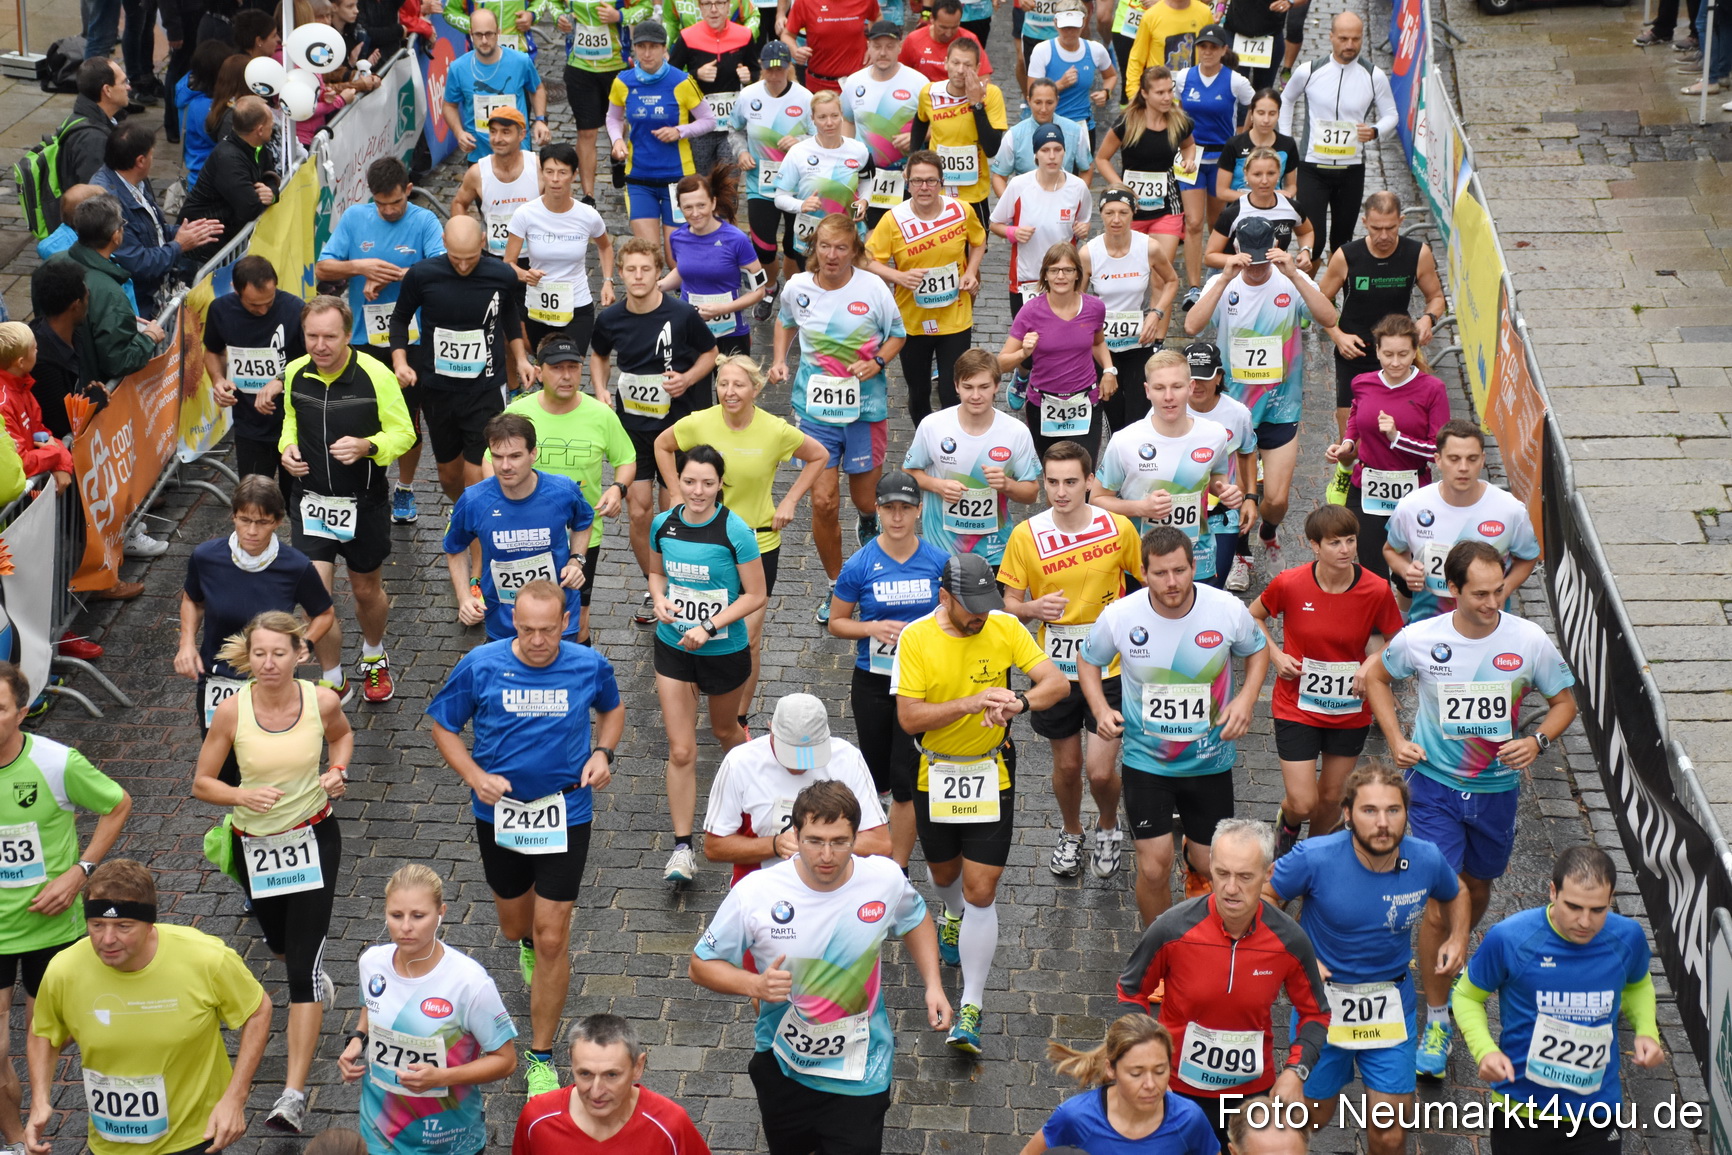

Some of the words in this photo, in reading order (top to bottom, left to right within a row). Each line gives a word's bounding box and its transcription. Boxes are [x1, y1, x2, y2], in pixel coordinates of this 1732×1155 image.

[578, 33, 608, 47] 2835
[1243, 41, 1264, 53] 174
[933, 110, 956, 121] MAX
[1323, 130, 1350, 145] 317
[1323, 146, 1346, 154] Thomas
[1127, 181, 1163, 197] 2733
[907, 239, 936, 256] MAX
[939, 225, 967, 244] BÖGL
[919, 274, 955, 294] 2811
[541, 293, 559, 309] 96
[924, 294, 953, 303] Christoph
[539, 312, 560, 320] Brigitte
[1102, 322, 1139, 337] 2497
[440, 340, 480, 359] 2577
[1245, 349, 1267, 366] 72
[234, 358, 275, 376] 2458
[449, 364, 471, 372] Tobias
[629, 385, 659, 402] 222
[813, 387, 856, 405] 2616
[634, 402, 658, 414] Thomas
[822, 409, 844, 417] Achim
[1046, 404, 1087, 421] 2435
[992, 450, 1009, 459] Hervis
[1368, 481, 1414, 499] 2302
[948, 499, 993, 516] 2622
[307, 503, 351, 528] 2052
[955, 520, 985, 529] Andreas
[1482, 524, 1501, 533] Hervis
[492, 528, 551, 543] HUBER
[1042, 555, 1078, 575] MAX
[1082, 542, 1121, 562] BÖGL
[665, 560, 709, 575] HUBER
[872, 579, 930, 594] HUBER
[674, 599, 722, 621] 2062
[1198, 634, 1220, 644] Hervis
[1497, 658, 1520, 667] Hervis
[1307, 673, 1354, 696] 2312
[502, 689, 568, 704] HUBER
[1150, 698, 1204, 719] 2514
[1446, 696, 1507, 720] 2789
[1160, 725, 1192, 733] Markus
[1457, 726, 1498, 735] Matthias
[1197, 737, 1212, 748] 17.
[944, 776, 985, 799] 267
[502, 805, 560, 829] 2420
[951, 804, 978, 815] Bernd
[515, 836, 548, 846] Werner
[253, 842, 312, 872] 2131
[267, 873, 305, 887] Manuela
[862, 905, 883, 918] Hervis
[1536, 990, 1614, 1007] HUBER
[424, 1002, 450, 1013] Hervis
[1342, 996, 1387, 1023] 207
[784, 1024, 845, 1056] 2323
[1352, 1028, 1381, 1039] Frank
[790, 1052, 821, 1067] Stefan
[1190, 1041, 1256, 1073] 2099
[1539, 1035, 1606, 1069] 2222
[1201, 1072, 1237, 1085] Robert
[1543, 1066, 1593, 1087] Christoph
[91, 1089, 160, 1117] 2020
[105, 1121, 148, 1135] Manfred
[423, 1119, 442, 1130] 17.
[422, 1135, 457, 1145] Stadtlauf
